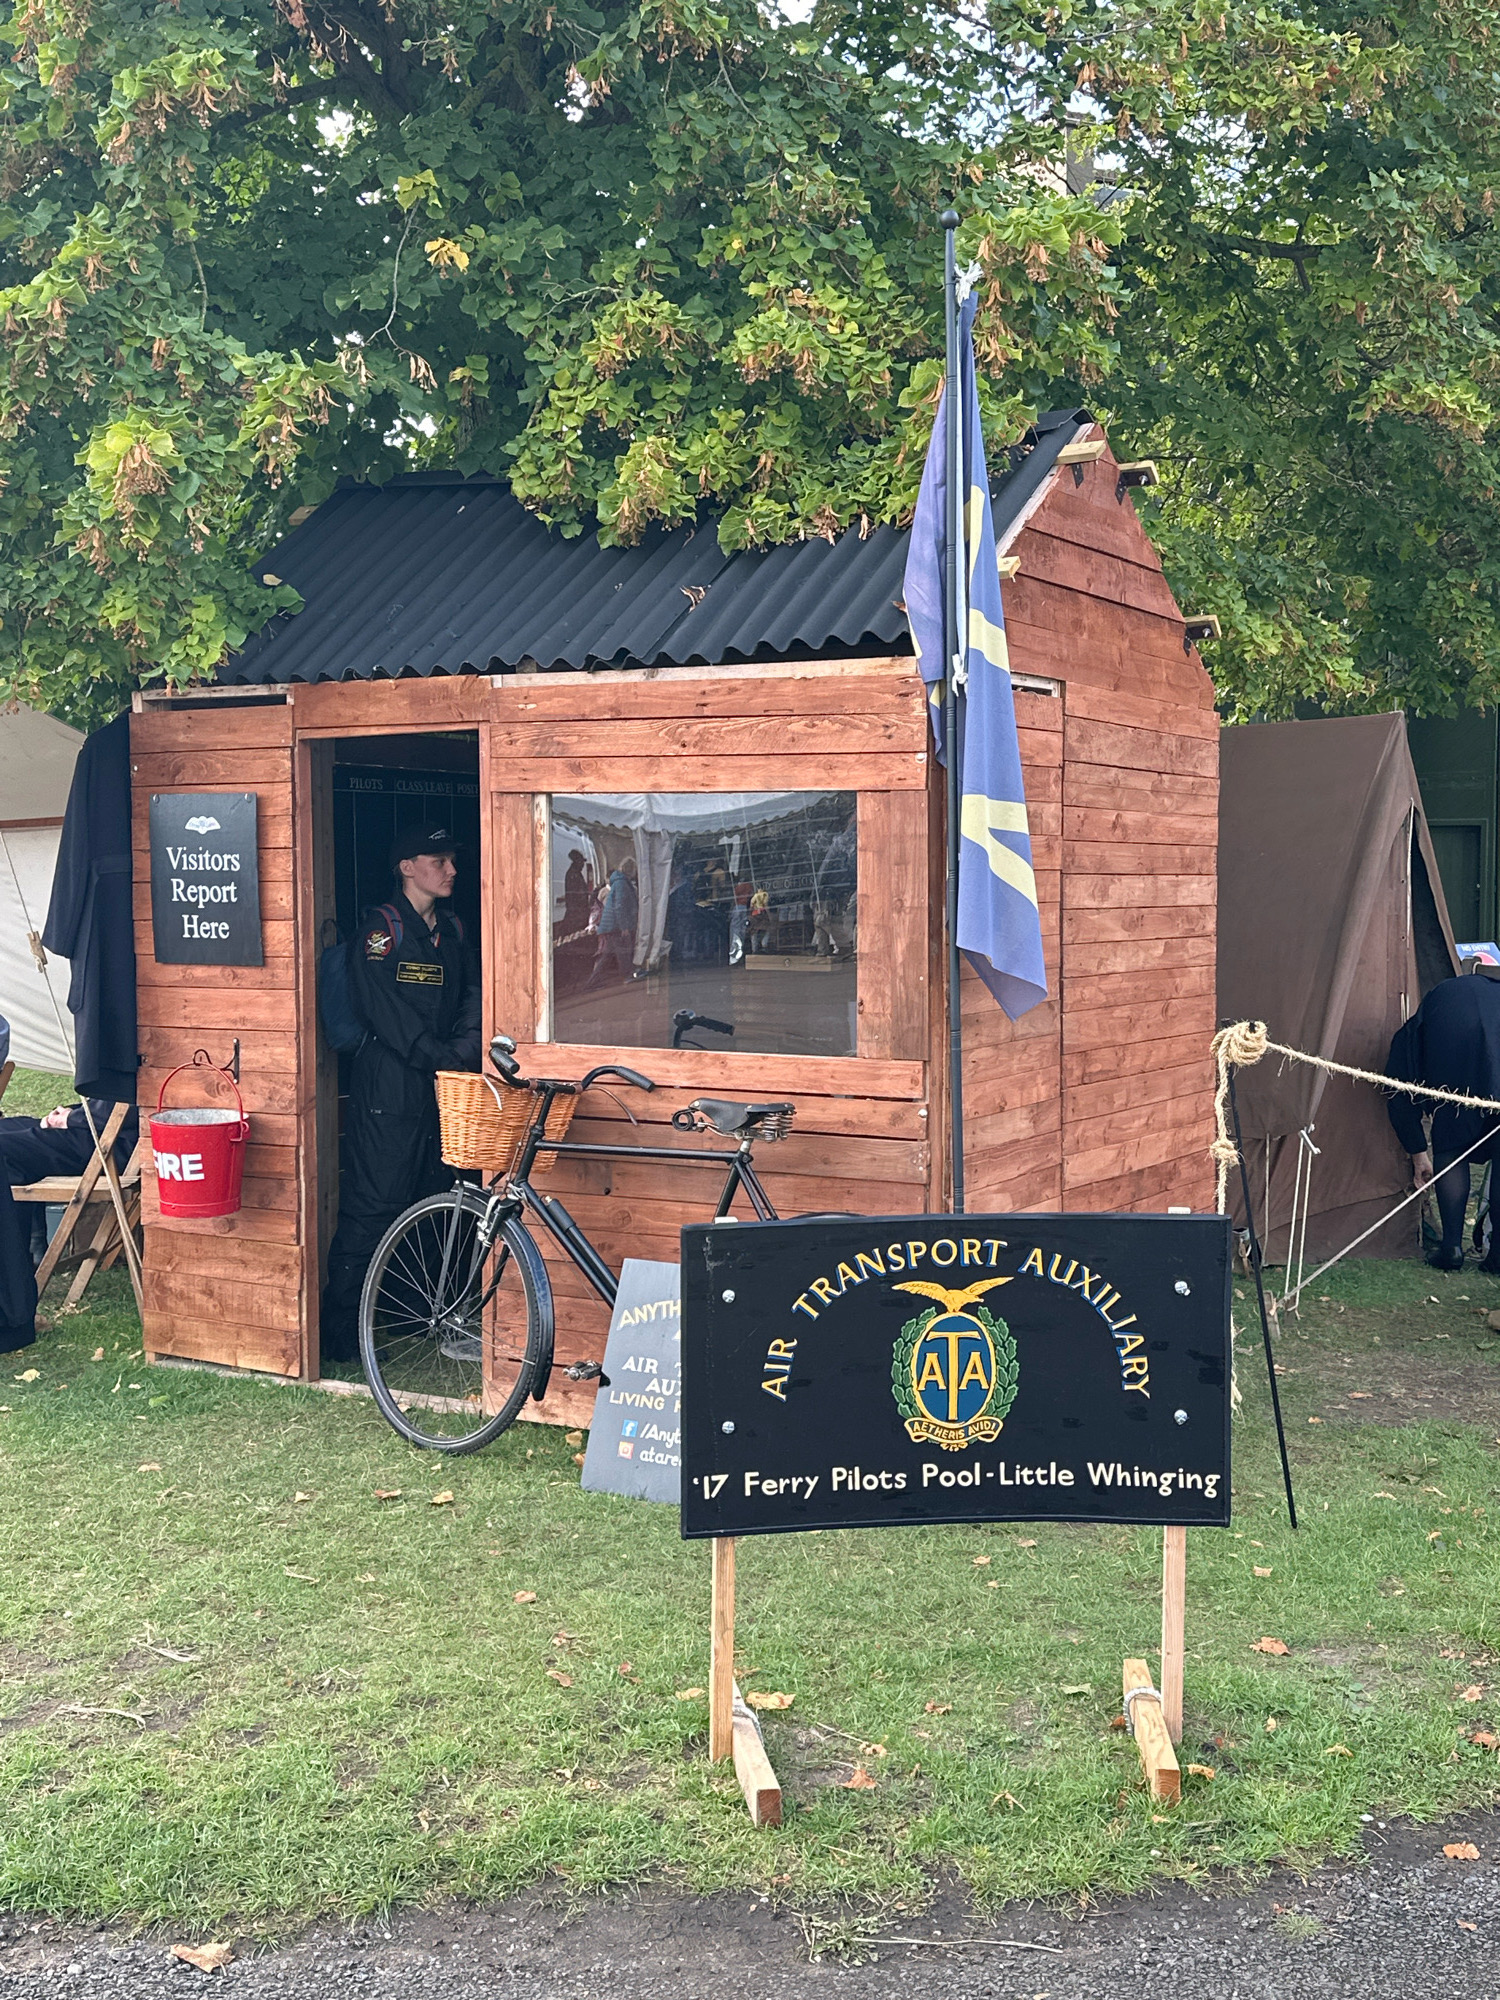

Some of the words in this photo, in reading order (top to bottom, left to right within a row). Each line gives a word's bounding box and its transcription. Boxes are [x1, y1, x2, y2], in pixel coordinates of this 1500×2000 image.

[350, 777, 384, 790] PILOTS
[396, 780, 424, 792] CLASS
[424, 782, 450, 794] LEAVE
[166, 847, 241, 871] Visitors
[170, 878, 238, 908] Report
[181, 914, 230, 939] Here
[761, 1338, 798, 1403] AIR
[791, 1239, 1008, 1321] TRANSPORT
[1018, 1248, 1151, 1400] AUXILIARY
[622, 1355, 659, 1375] AIR
[609, 1391, 665, 1411] LIVING
[913, 1421, 965, 1440] AETHERIS
[968, 1421, 996, 1436] AVIDI
[744, 1471, 819, 1499] Ferry
[832, 1466, 907, 1491] Pilots
[1087, 1462, 1221, 1498] Whinging
